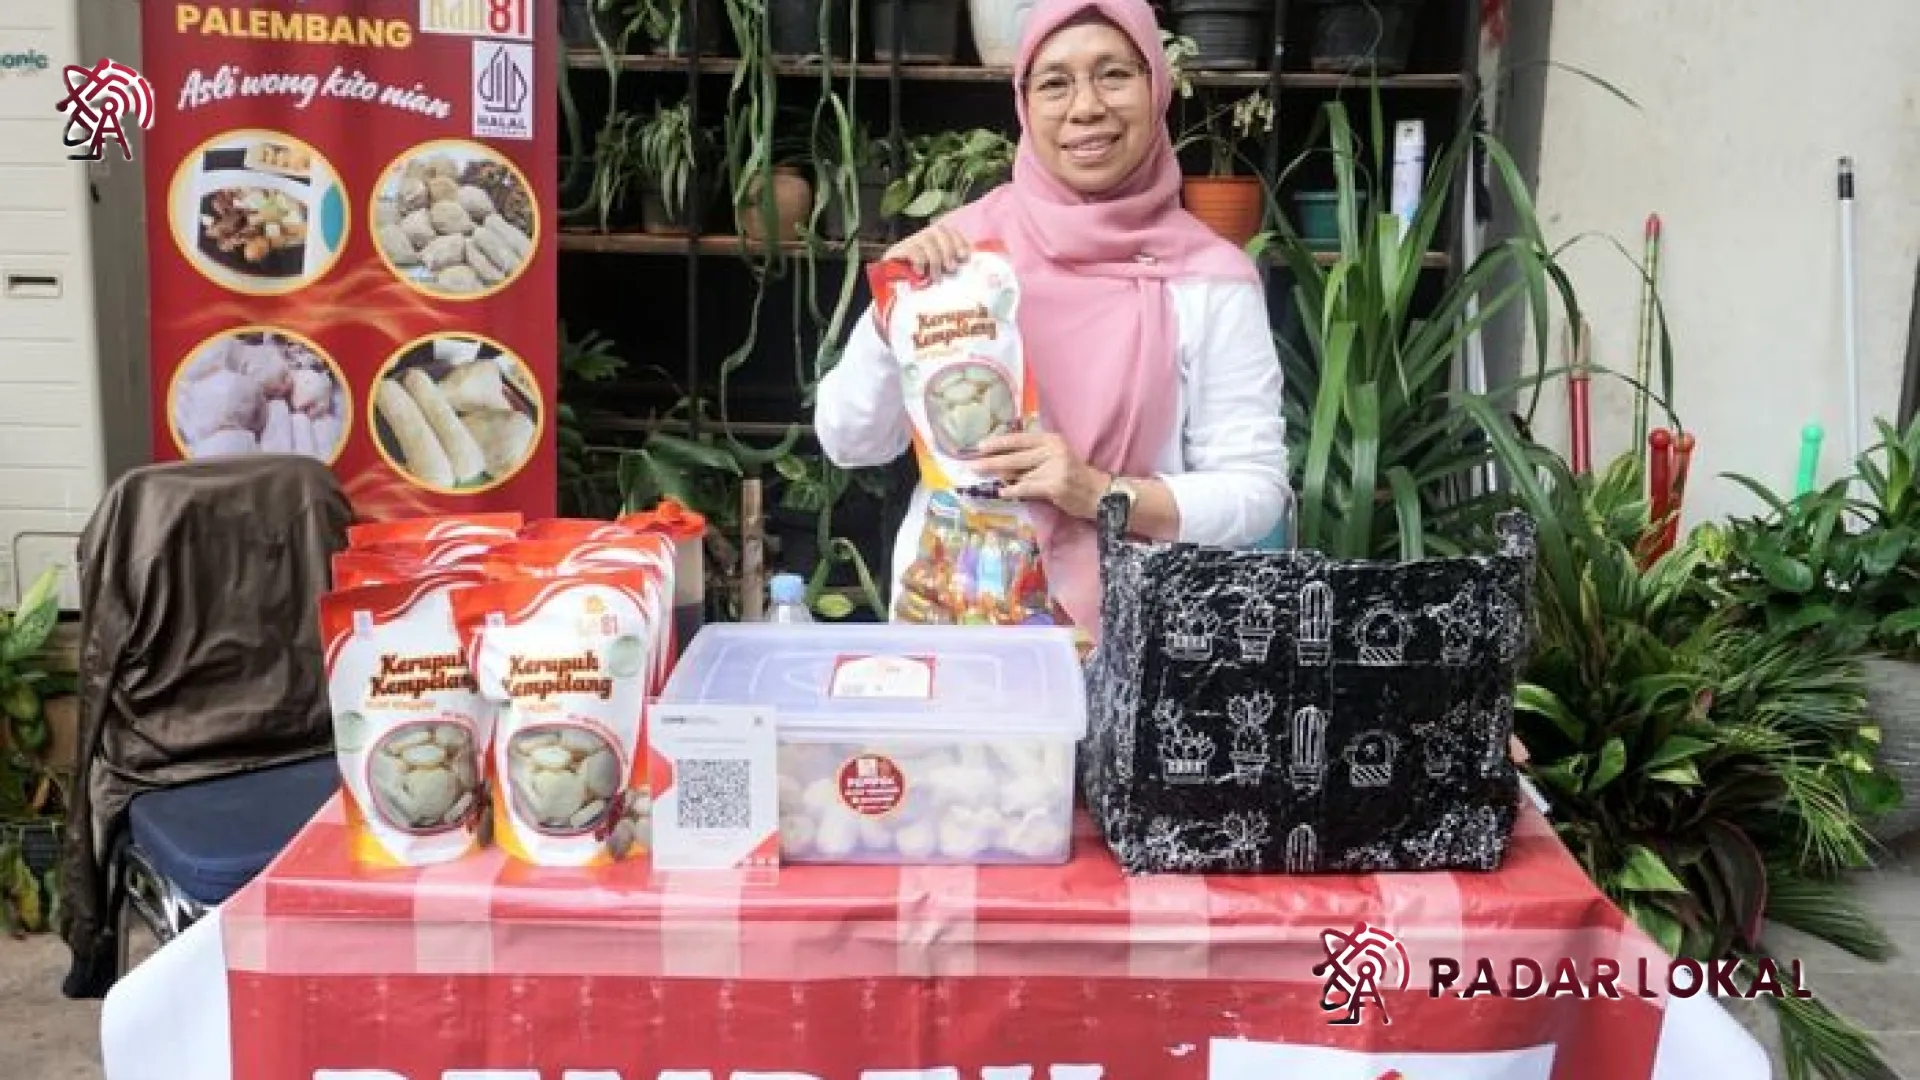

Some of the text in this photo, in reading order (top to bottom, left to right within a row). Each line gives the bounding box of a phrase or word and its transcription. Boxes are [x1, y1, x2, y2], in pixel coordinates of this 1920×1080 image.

[176, 3, 413, 49] PALEMBANG
[177, 65, 450, 118] Asli wong kito nian
